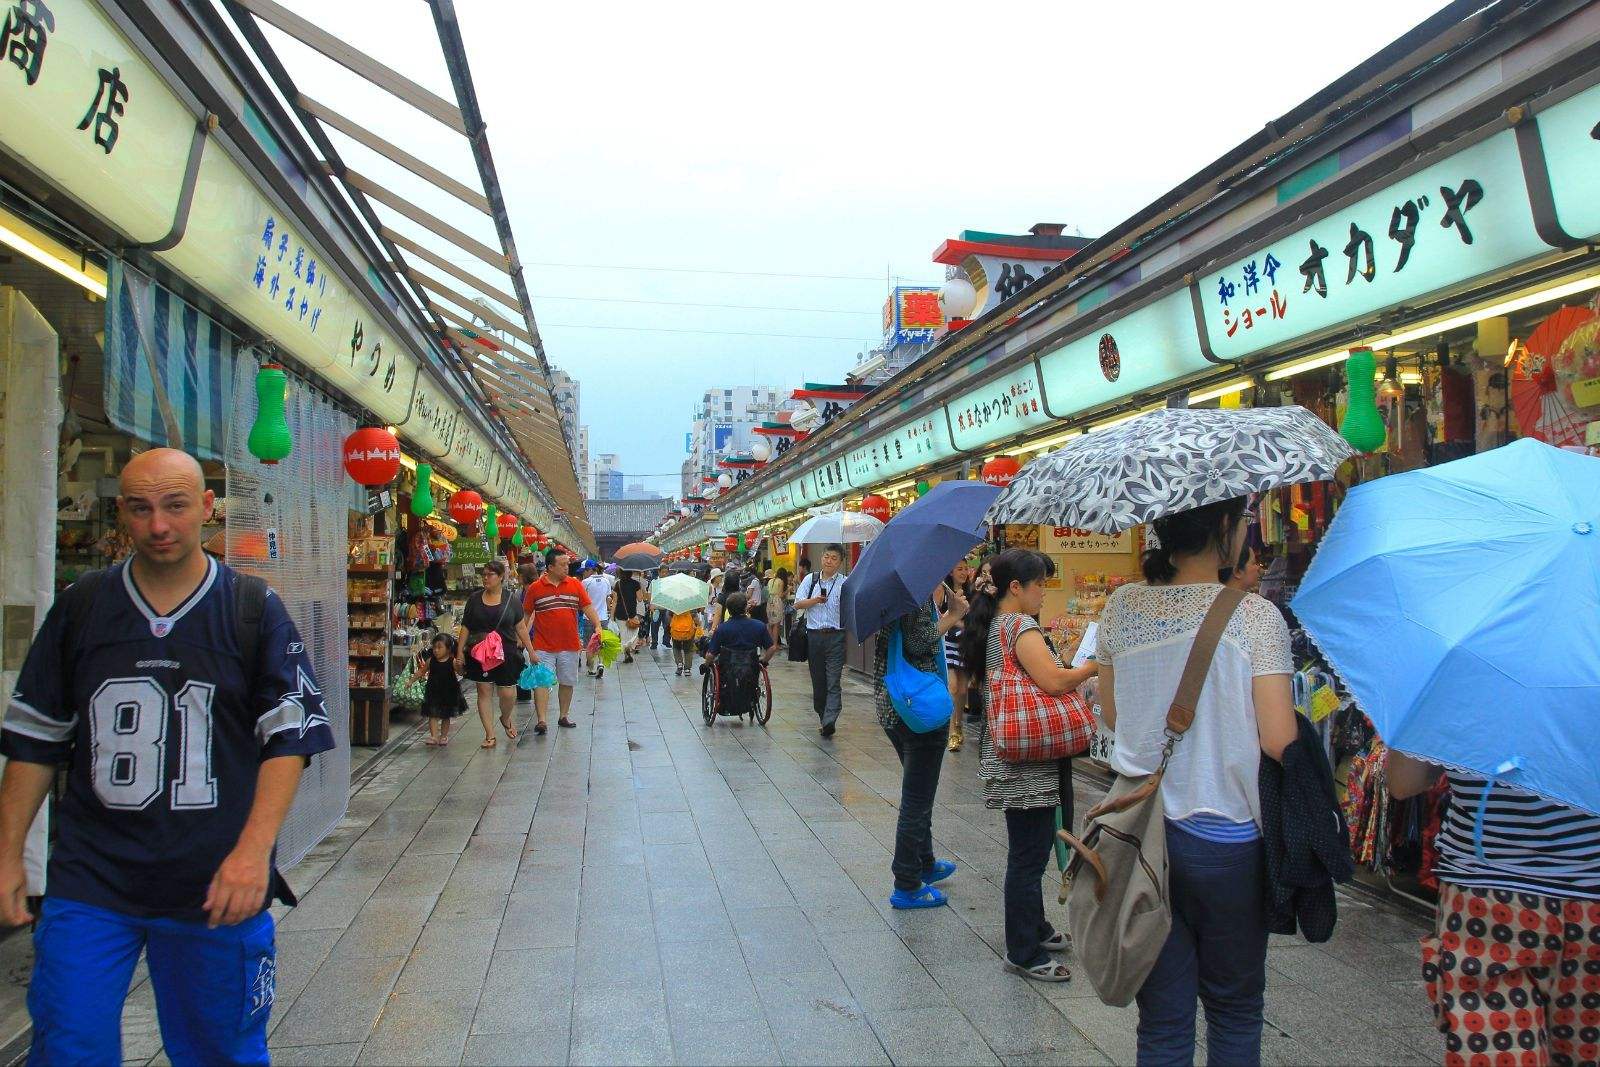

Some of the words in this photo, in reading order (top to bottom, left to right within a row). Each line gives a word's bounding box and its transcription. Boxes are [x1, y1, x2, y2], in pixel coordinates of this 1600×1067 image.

[1300, 178, 1484, 299] オカダヤ
[1223, 290, 1287, 338] ショール
[268, 531, 278, 559] 仲見世
[1060, 539, 1120, 549] 仲見せなかつか
[89, 676, 219, 811] 81
